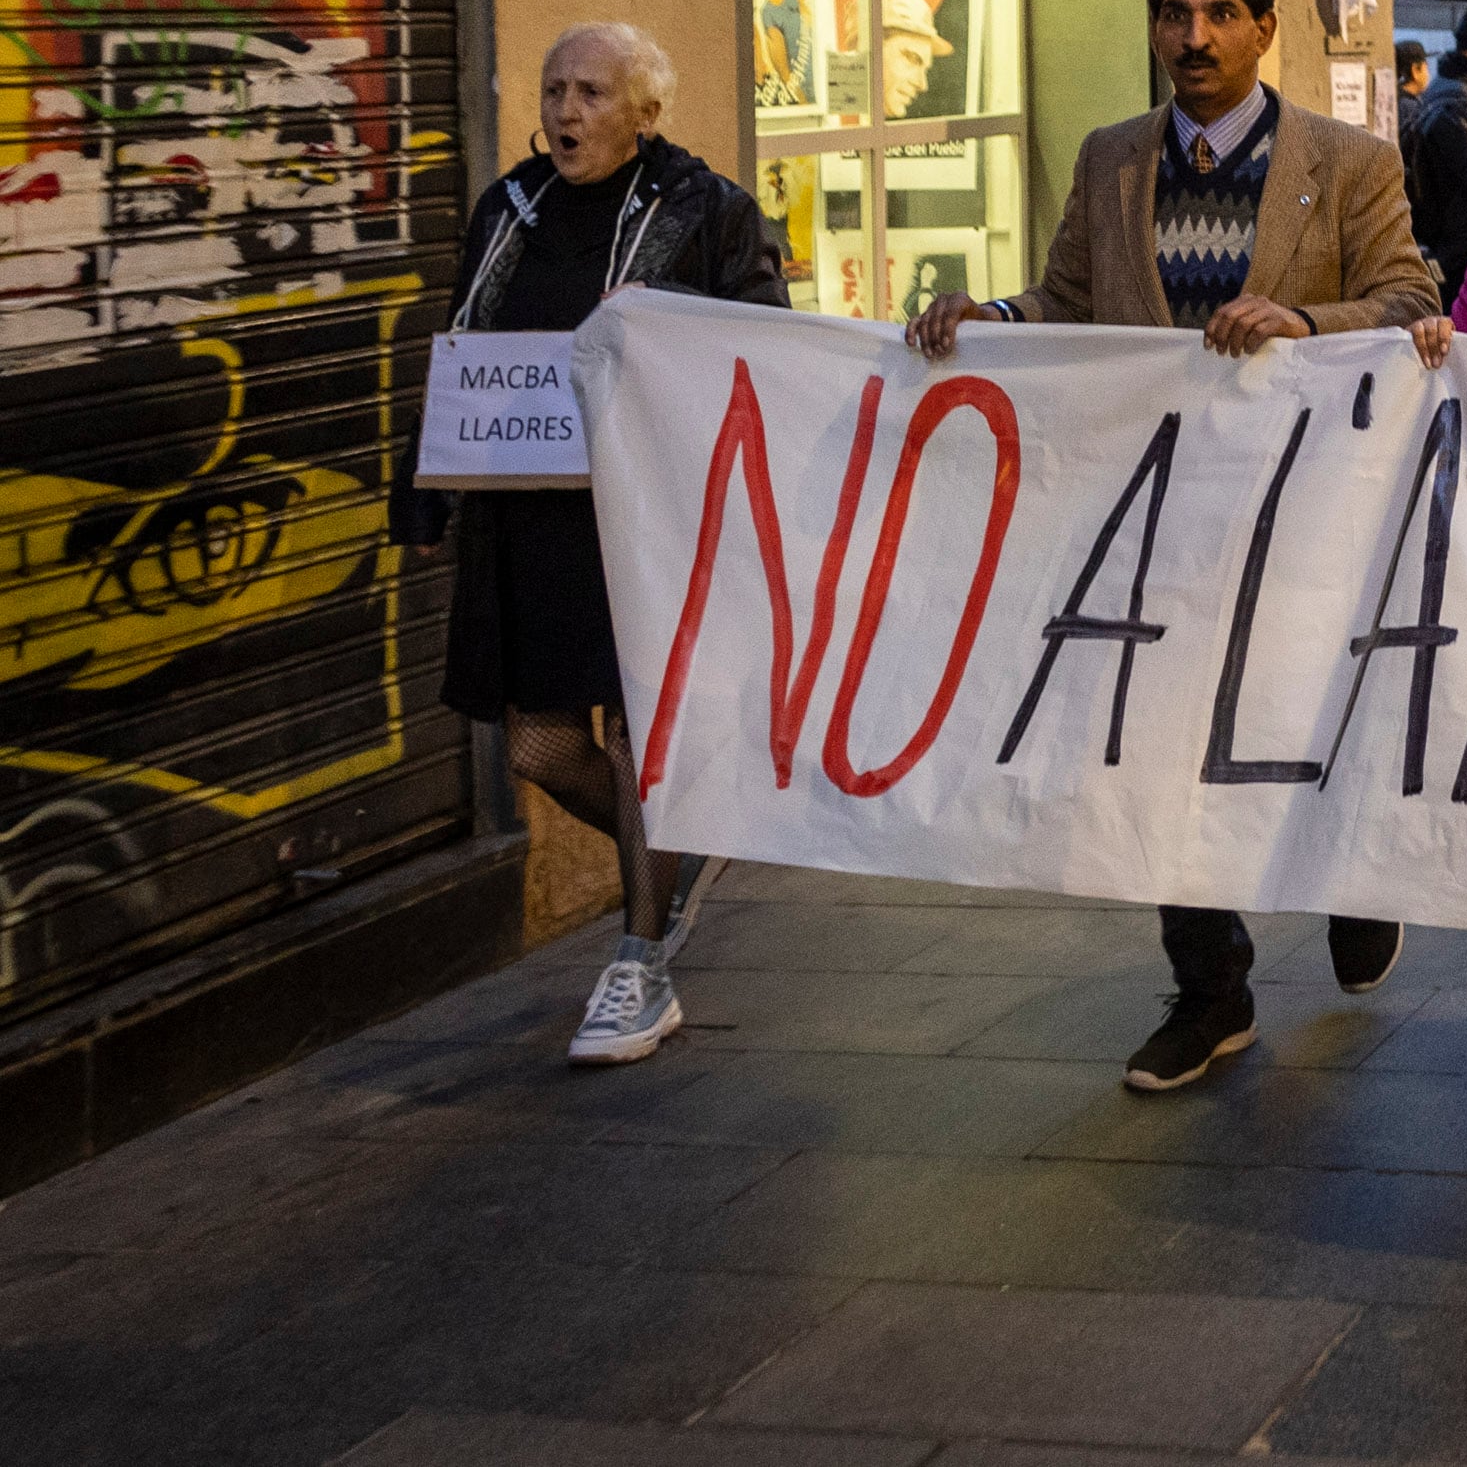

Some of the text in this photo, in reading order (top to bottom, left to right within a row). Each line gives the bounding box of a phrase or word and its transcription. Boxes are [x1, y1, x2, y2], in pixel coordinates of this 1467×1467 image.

[459, 364, 560, 391] MACBA
[458, 415, 574, 442] LLADRES
[640, 356, 1021, 802] NO
[995, 410, 1168, 768] A
